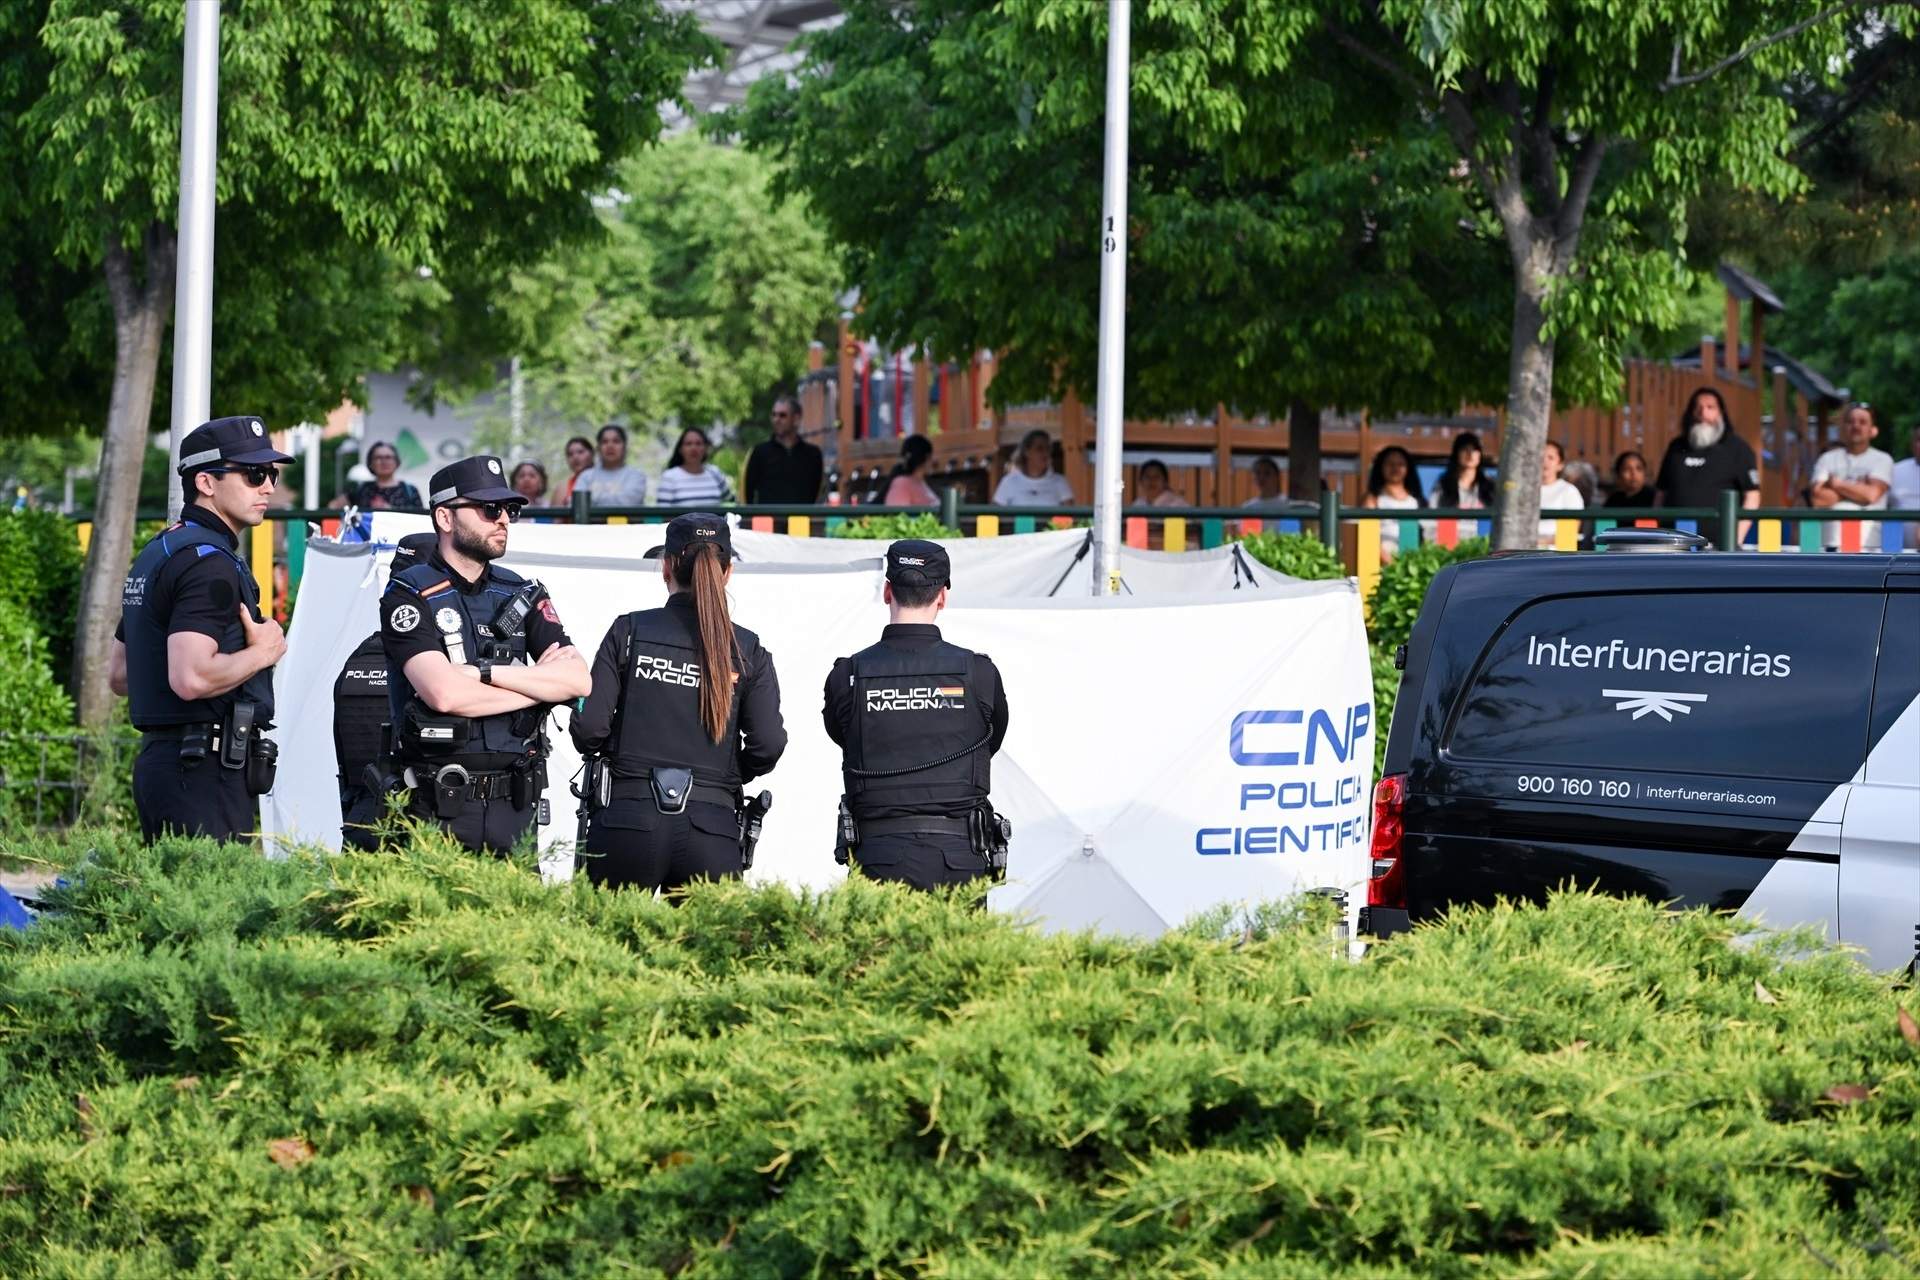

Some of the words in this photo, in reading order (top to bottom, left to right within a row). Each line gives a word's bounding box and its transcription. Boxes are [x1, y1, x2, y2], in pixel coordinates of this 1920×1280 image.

[1104, 215, 1116, 253] 19
[345, 670, 388, 679] POLICIA
[1527, 635, 1792, 678] Interfunerarias
[866, 687, 944, 701] POLICIA
[867, 698, 965, 712] NACIONAL
[1229, 702, 1371, 767] CNP
[1240, 774, 1362, 811] POLICIA
[1518, 775, 1555, 793] 900
[1561, 778, 1593, 796] 160
[1599, 780, 1631, 798] 160
[1646, 785, 1776, 805] interfunerarias.com
[1196, 815, 1365, 856] CIENTIFIC
